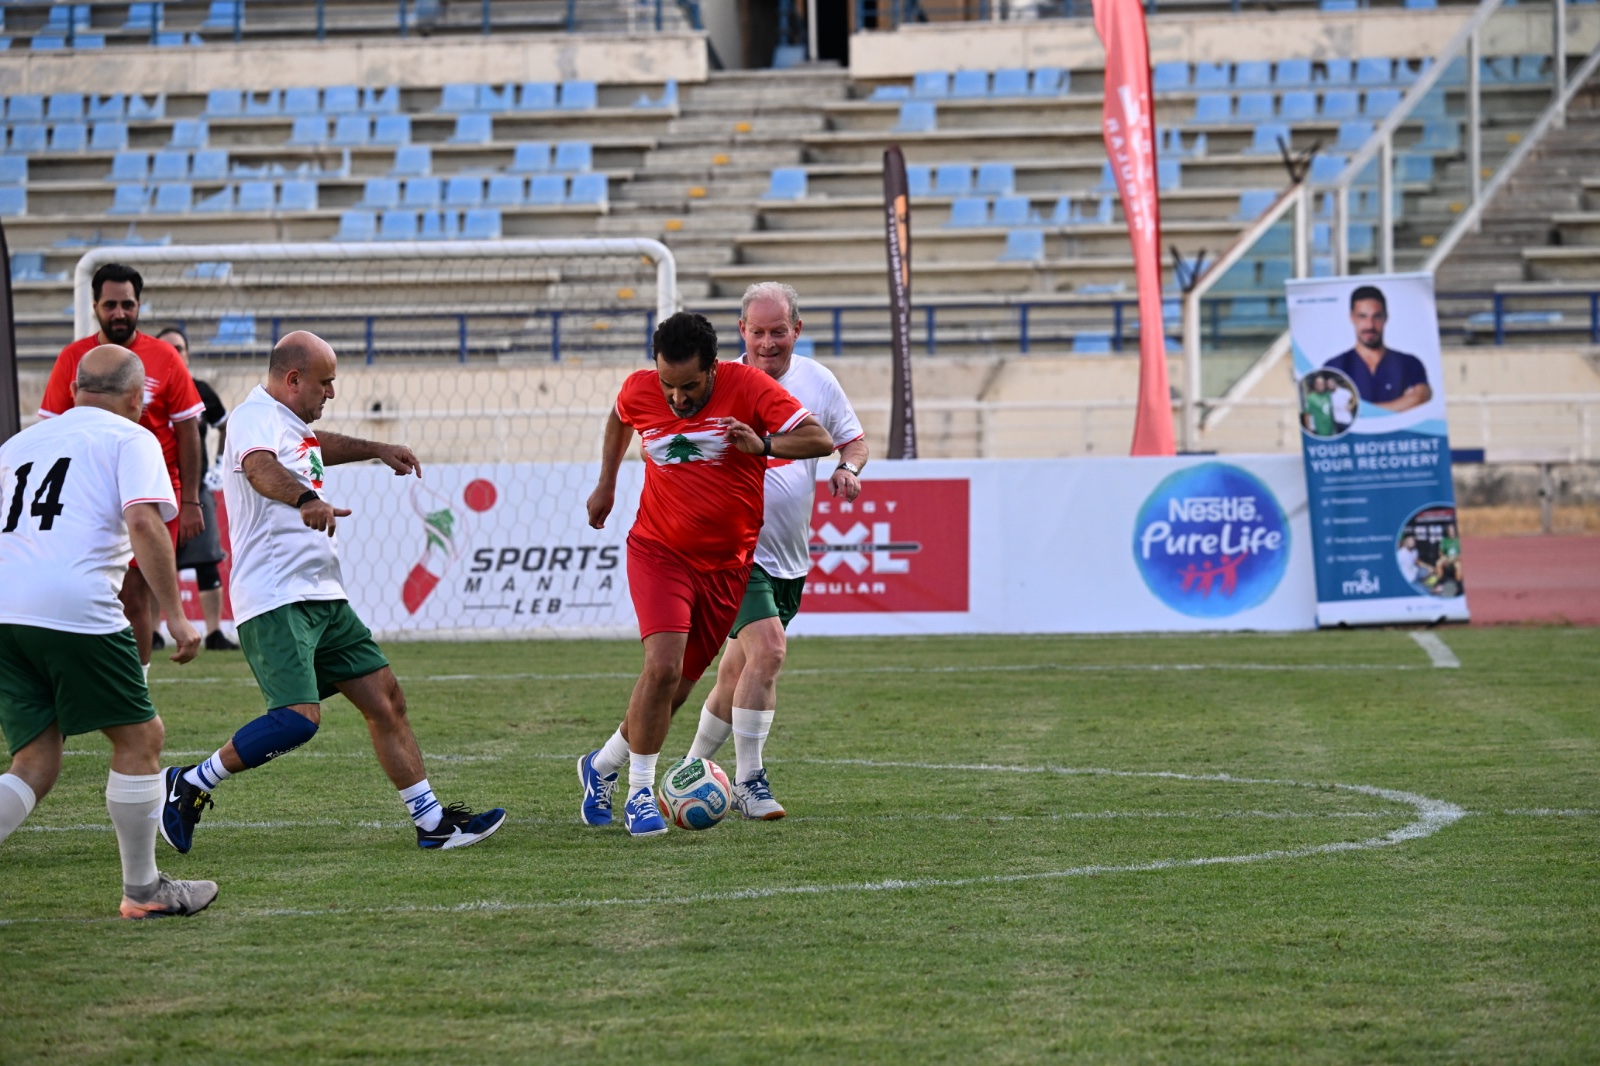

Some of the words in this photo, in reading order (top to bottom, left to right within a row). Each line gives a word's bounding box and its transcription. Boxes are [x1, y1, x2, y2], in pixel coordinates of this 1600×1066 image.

[1307, 443, 1350, 459] YOUR
[1353, 437, 1439, 455] MOVEMENT
[1311, 457, 1353, 473] YOUR
[1357, 453, 1439, 470] RECOVERY
[1, 457, 71, 533] 14
[809, 520, 910, 575] XL
[470, 545, 620, 573] SPORTS
[463, 575, 613, 593] MANIA
[802, 582, 886, 595] EGULAR
[513, 598, 562, 615] LEB
